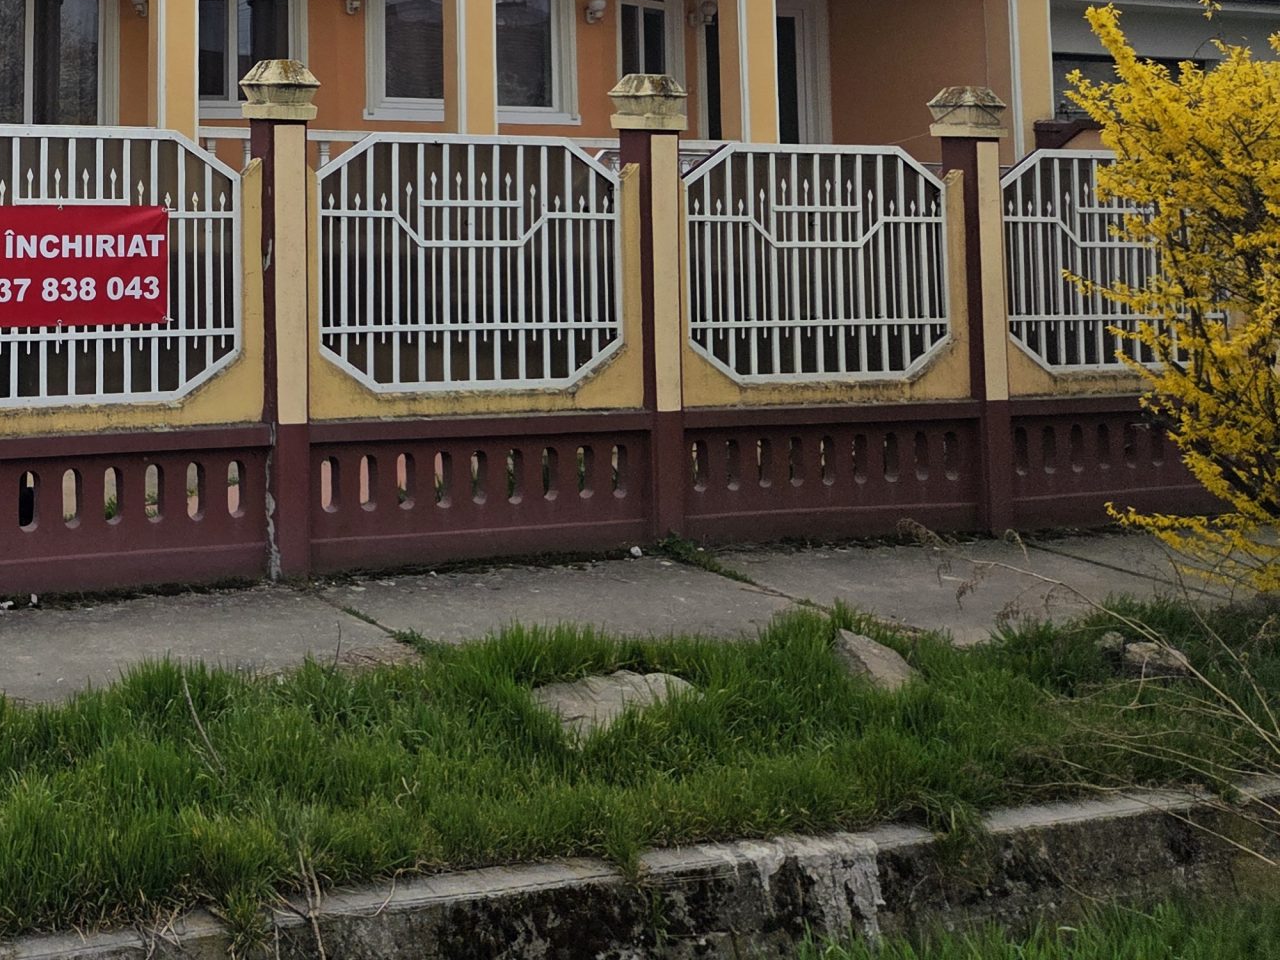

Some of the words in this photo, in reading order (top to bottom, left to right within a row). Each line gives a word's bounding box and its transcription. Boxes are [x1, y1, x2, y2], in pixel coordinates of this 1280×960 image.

[4, 229, 165, 259] ÎNCHIRIAT
[41, 277, 97, 302] 838
[106, 276, 160, 301] 043
